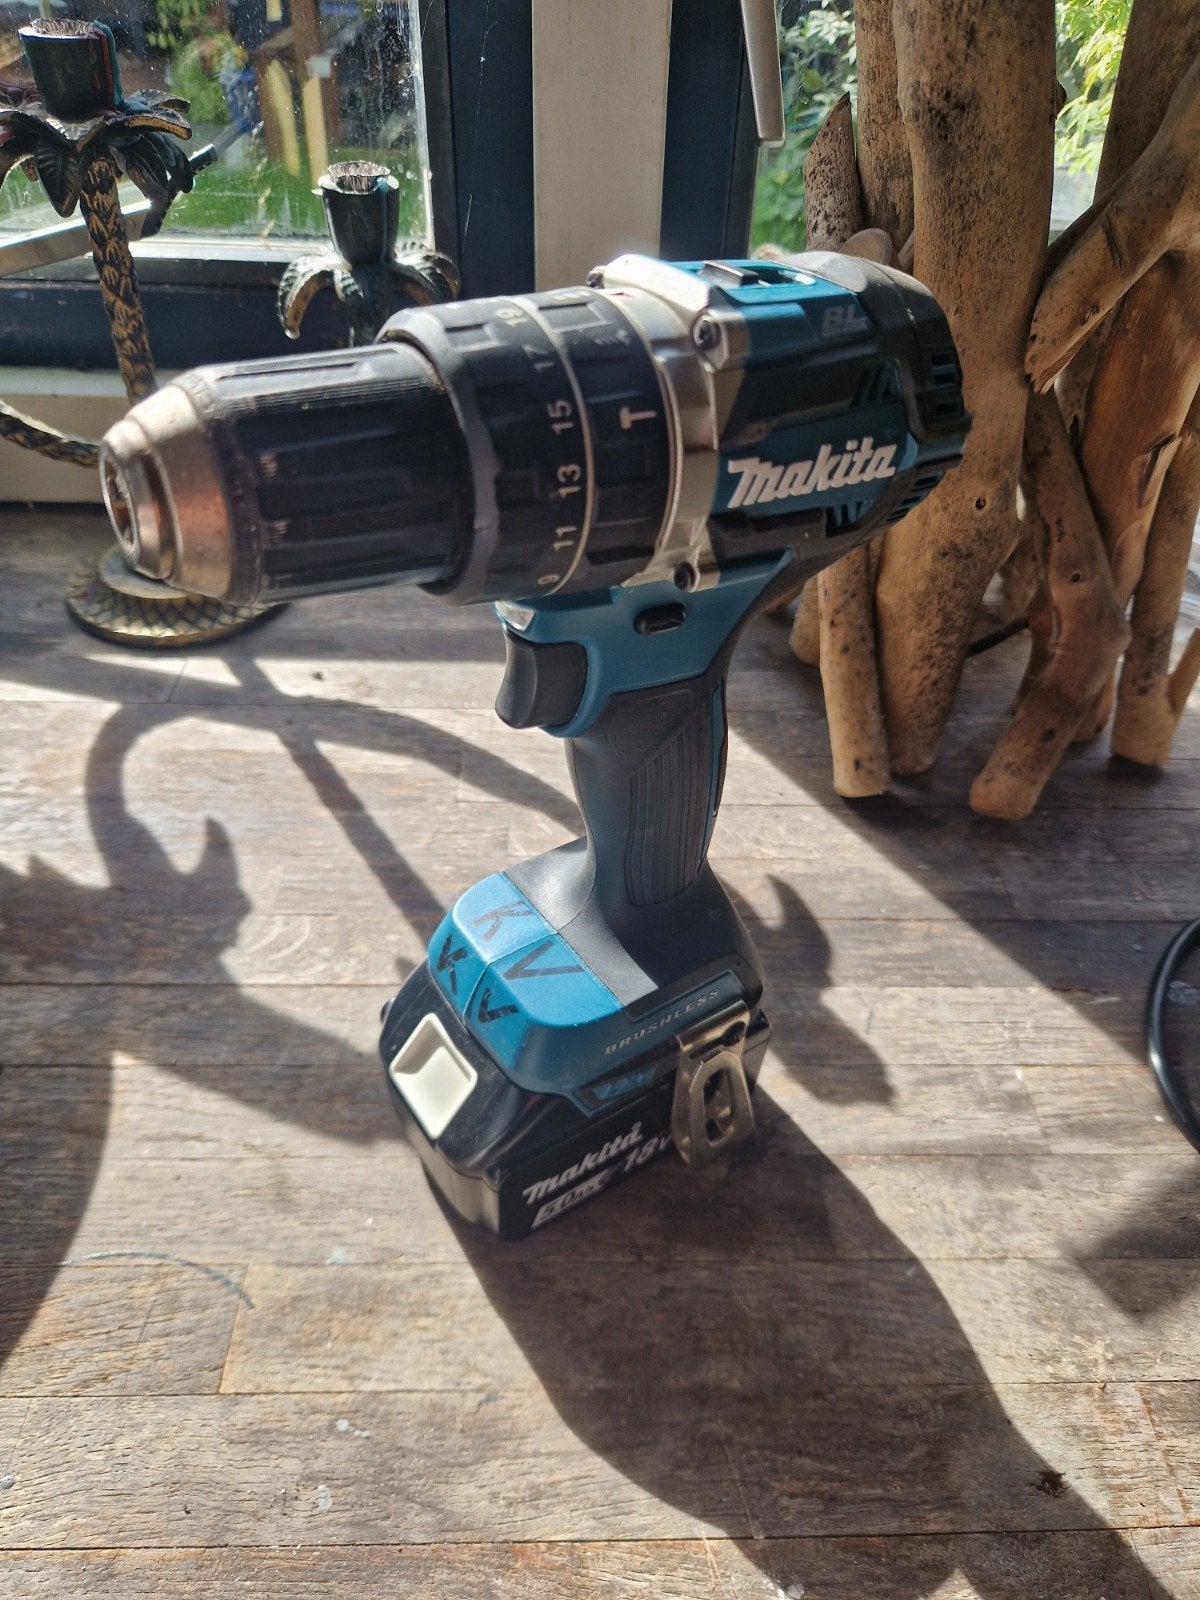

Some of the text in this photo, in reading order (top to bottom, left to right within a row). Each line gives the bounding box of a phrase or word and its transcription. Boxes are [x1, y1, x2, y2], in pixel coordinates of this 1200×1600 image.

[495, 307, 528, 328] 19
[822, 304, 867, 329] BL
[522, 344, 555, 374] 17
[547, 399, 575, 436] 15
[558, 463, 582, 499] 13
[552, 524, 575, 552] 11
[471, 901, 585, 981] K V
[436, 934, 519, 1024] K V
[604, 988, 720, 1055] BRUSHLESS
